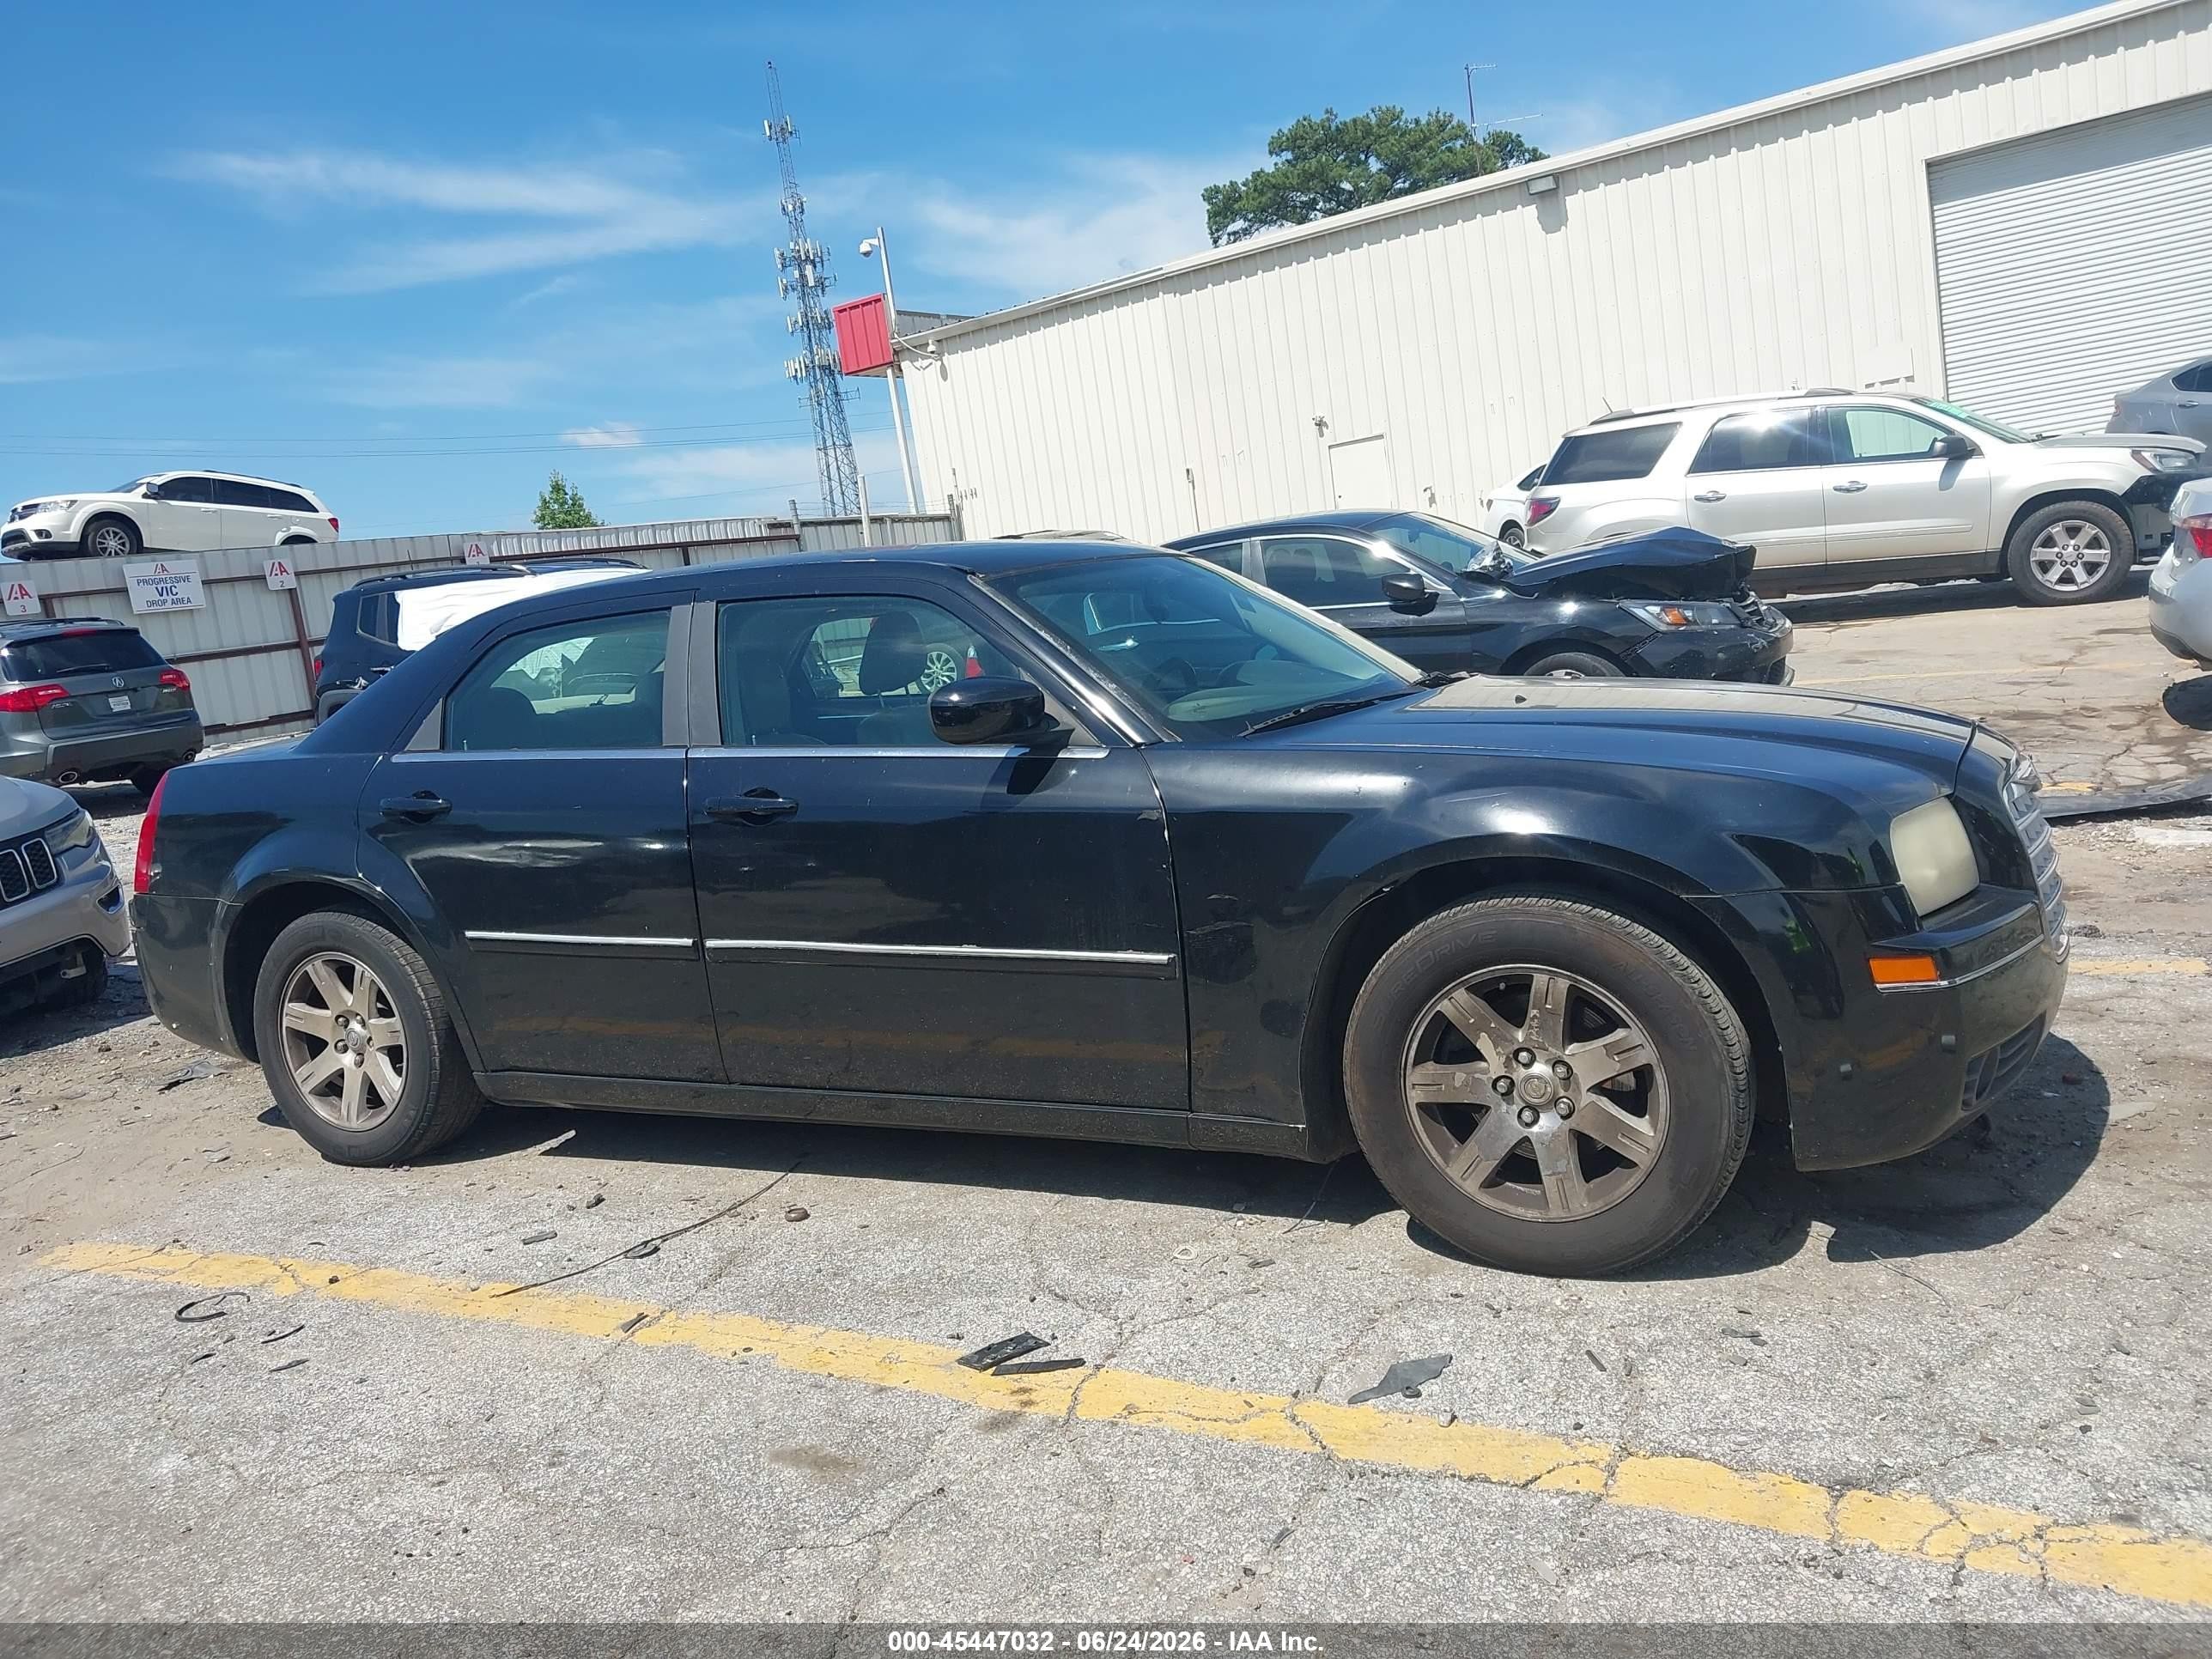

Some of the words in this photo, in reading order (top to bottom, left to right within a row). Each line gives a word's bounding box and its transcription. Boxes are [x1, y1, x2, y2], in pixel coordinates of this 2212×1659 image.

[137, 575, 191, 586] PROGRESSIVE
[155, 586, 179, 597] VIC
[146, 599, 168, 608] DROP
[171, 597, 192, 605] AREA
